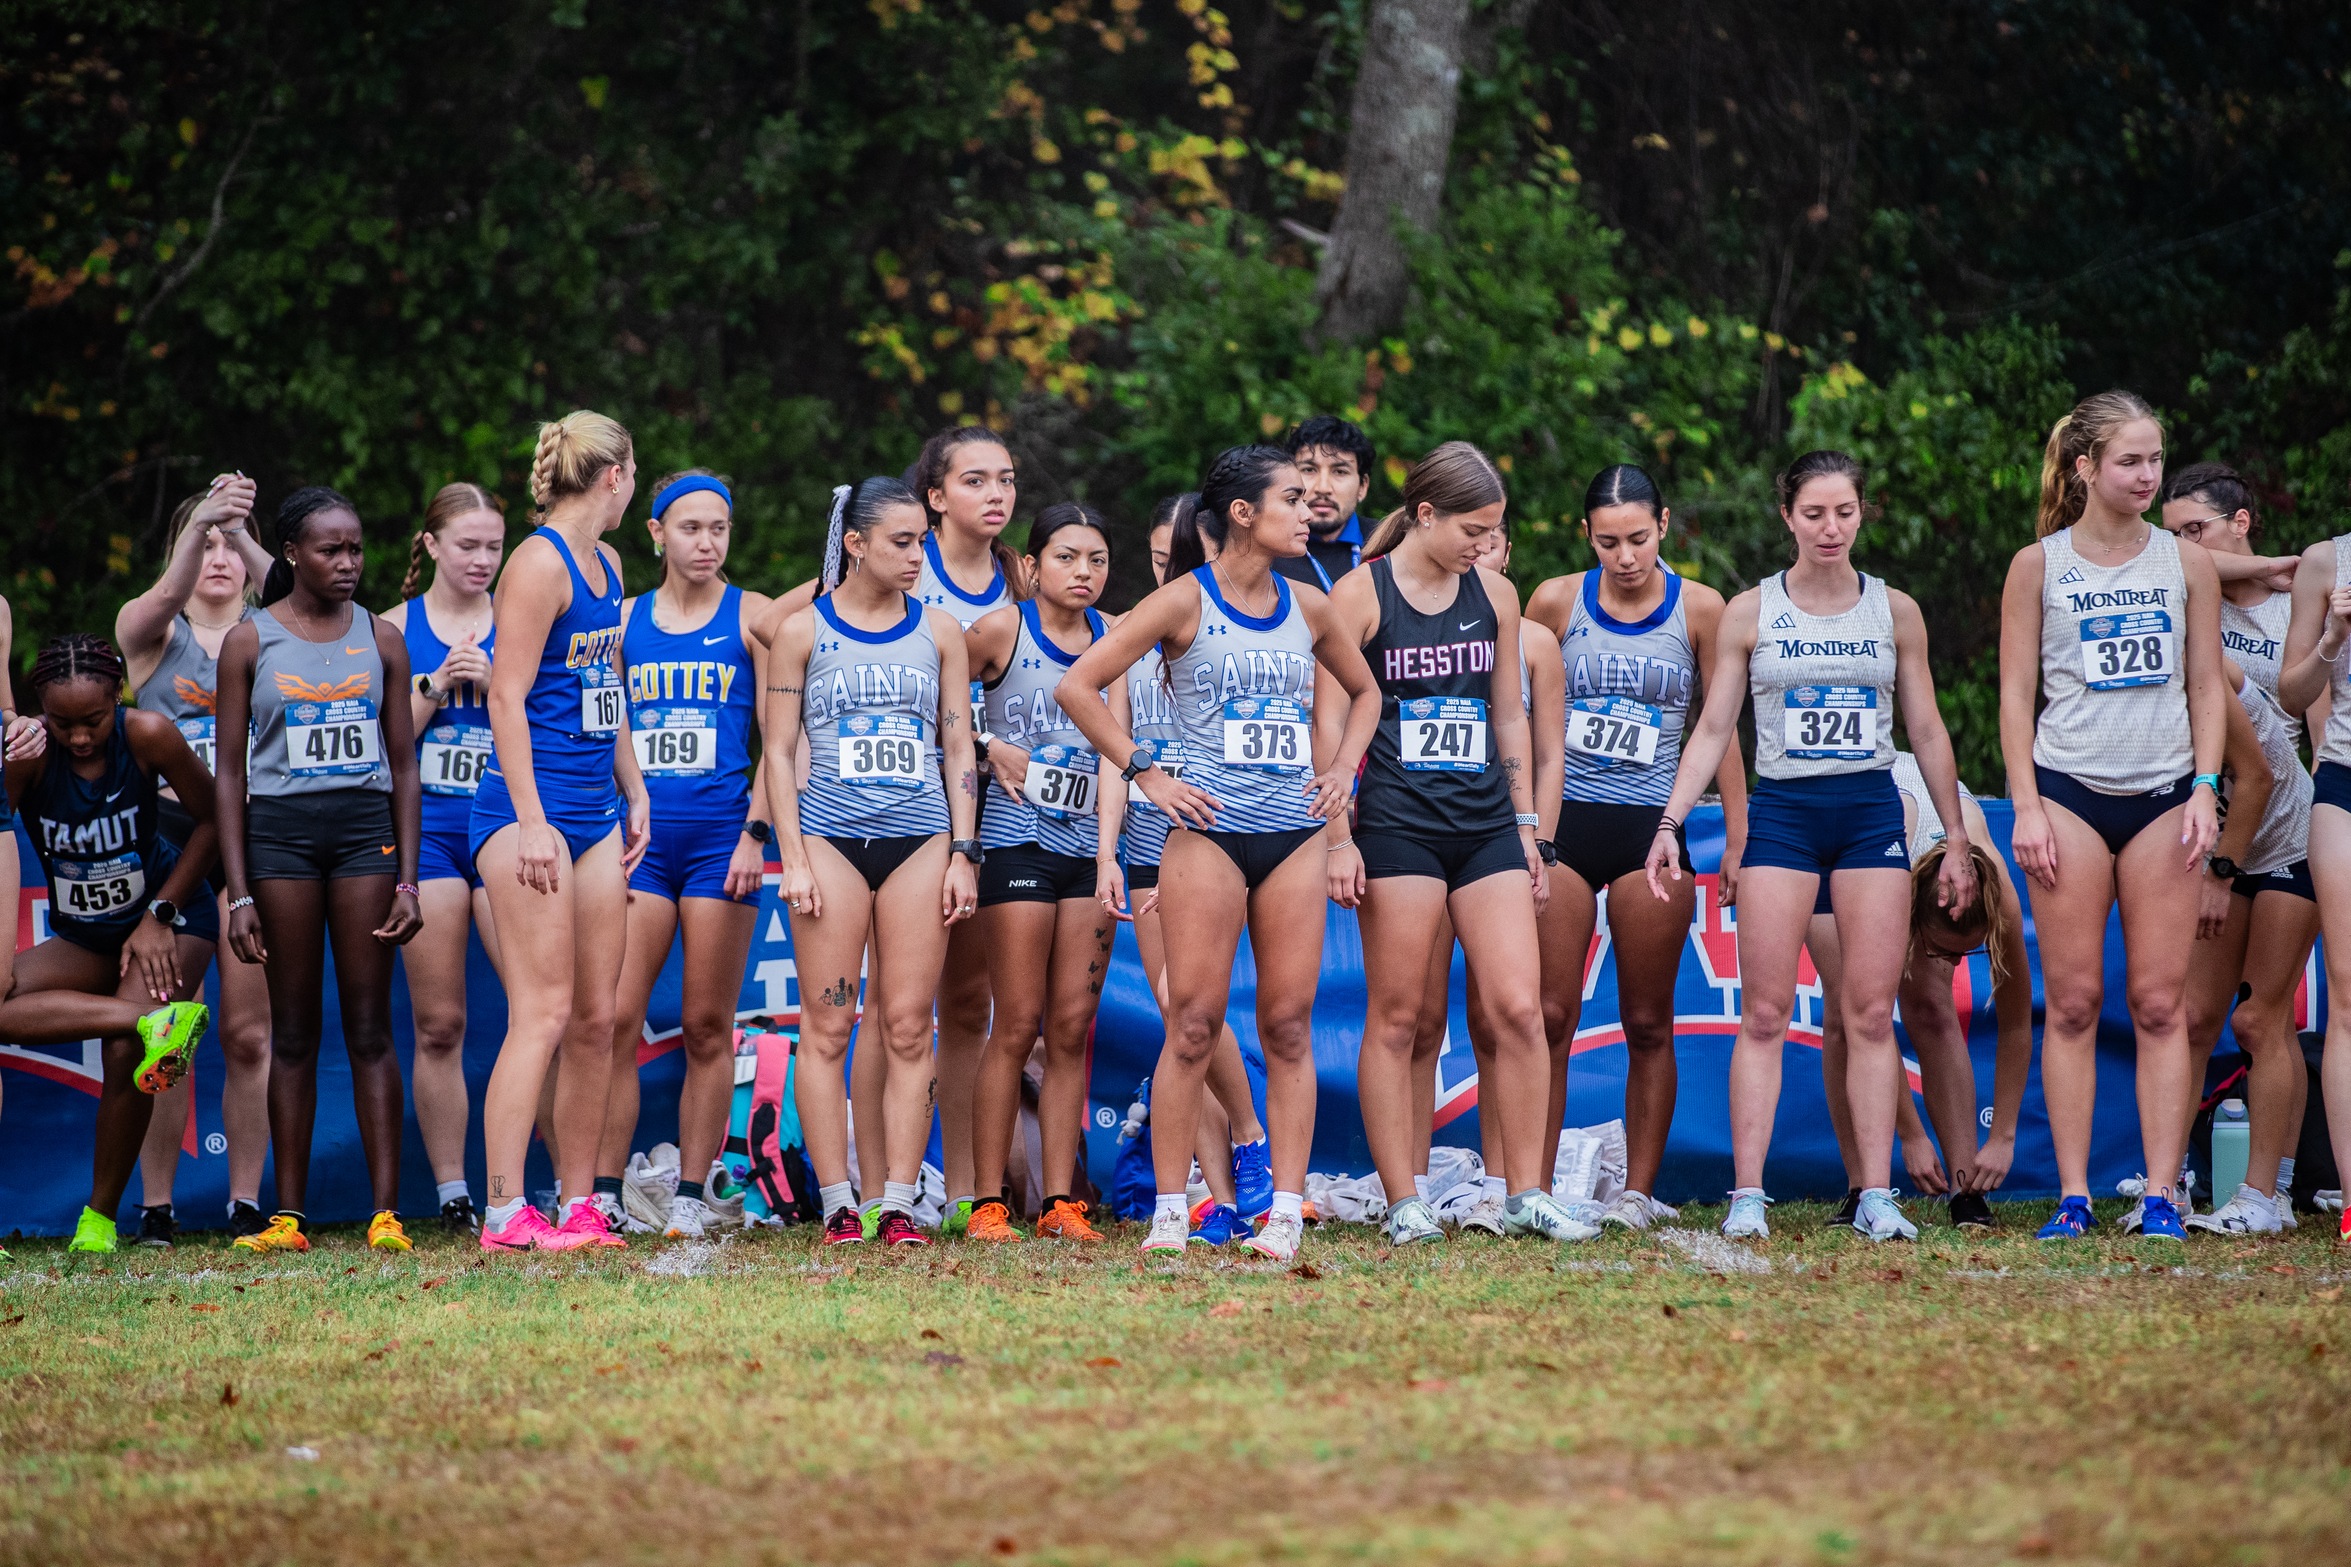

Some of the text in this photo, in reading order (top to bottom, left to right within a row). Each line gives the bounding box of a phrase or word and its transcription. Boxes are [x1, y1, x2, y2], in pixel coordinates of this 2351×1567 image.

[1385, 641, 1495, 680] HESSTON
[2098, 636, 2163, 675] 328
[628, 662, 737, 703] COTTEY
[808, 664, 939, 729] SAINTS
[1564, 653, 1692, 708] AINTS
[595, 690, 619, 726] 167
[306, 725, 363, 761] 476
[1242, 723, 1297, 760] 373
[1419, 723, 1473, 757] 247
[1582, 716, 1641, 757] 374
[1801, 711, 1863, 745] 324
[438, 748, 489, 783] 168
[645, 731, 698, 764] 169
[854, 739, 915, 774] 369
[1041, 769, 1089, 809] 370
[40, 805, 139, 853] TAMUT
[69, 878, 132, 911] 453
[1009, 880, 1038, 888] NIKE
